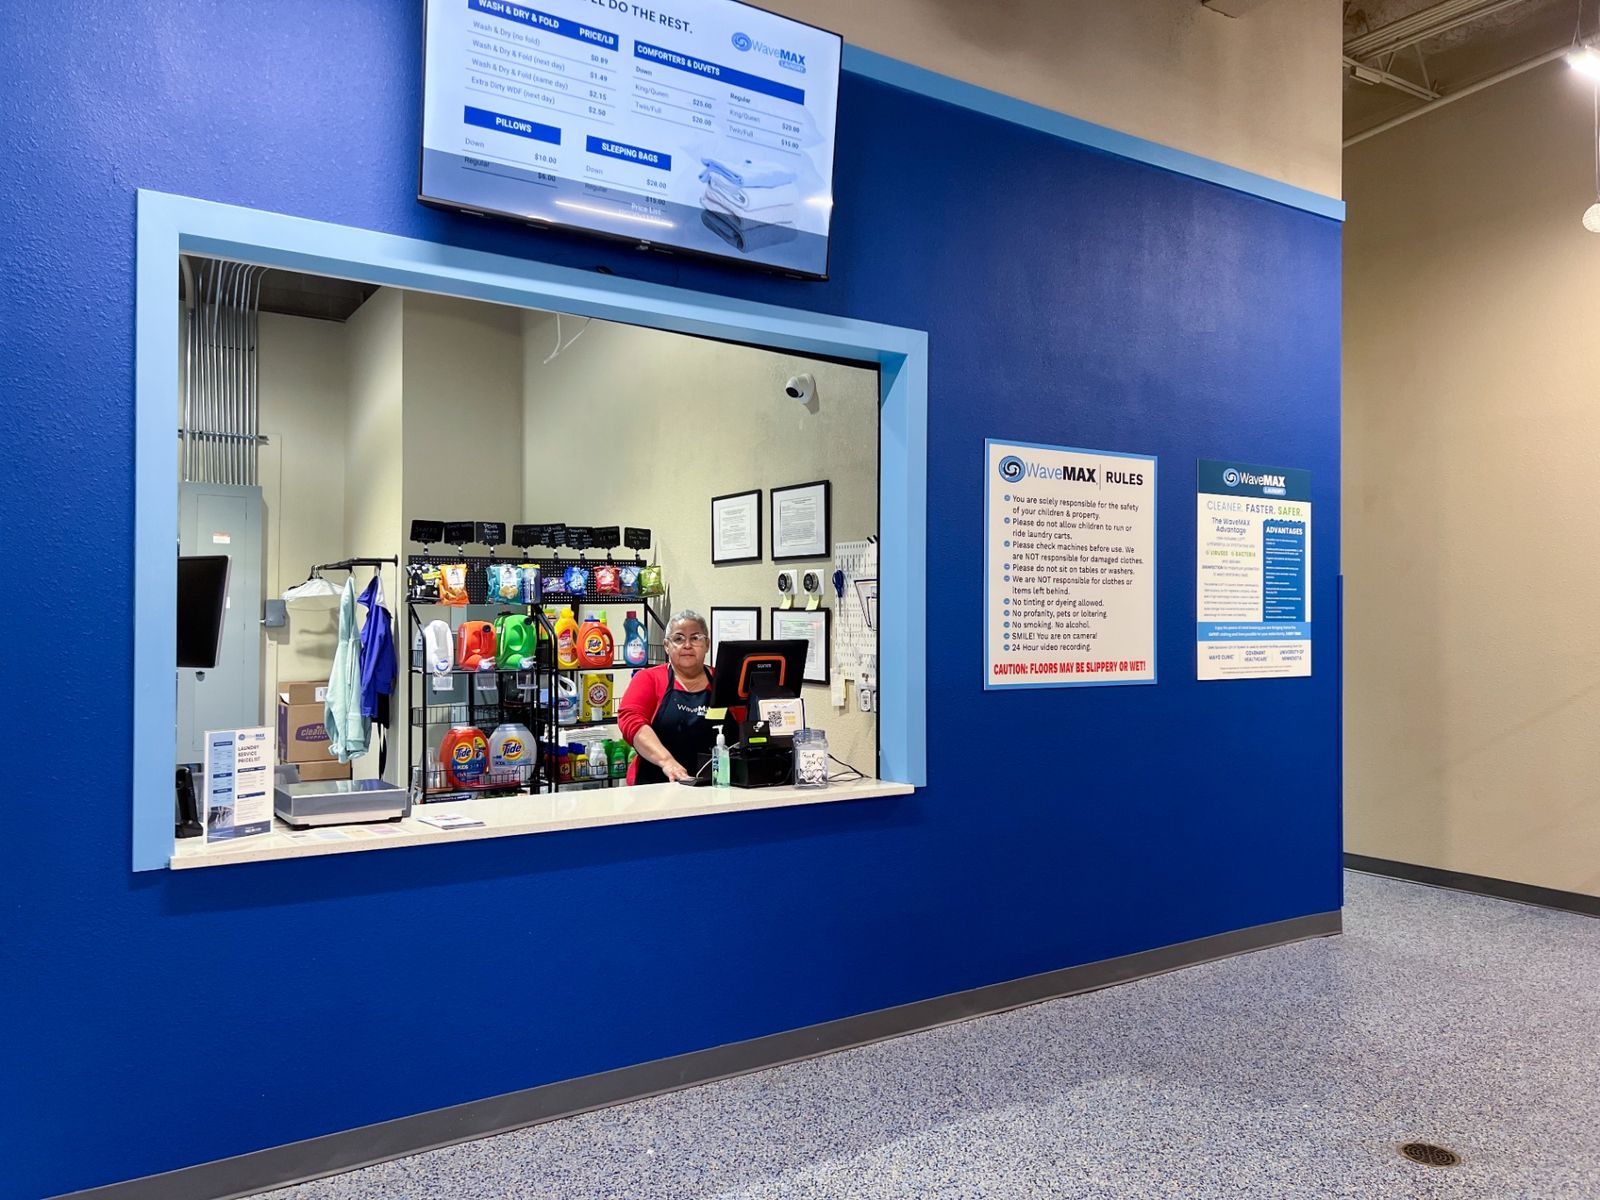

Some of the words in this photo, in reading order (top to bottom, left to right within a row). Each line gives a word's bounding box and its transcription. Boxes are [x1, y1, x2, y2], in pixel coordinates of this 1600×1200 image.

[478, 0, 504, 13] WASH
[506, 6, 512, 15] &
[514, 8, 529, 20] DRY
[531, 14, 537, 22] &
[539, 16, 559, 28] FOLD
[580, 27, 614, 45] PRICE/LB
[609, 0, 628, 13] DO
[632, 5, 656, 22] THE
[659, 14, 693, 34] REST.
[473, 20, 492, 32] Wash
[500, 27, 511, 38] Dry
[472, 39, 492, 51] Wash
[500, 46, 510, 56] Dry
[518, 51, 532, 63] Fold
[752, 40, 806, 66] WaveMAX
[638, 45, 686, 66] COMFORTERS
[687, 58, 692, 68] &
[693, 61, 720, 76] DUVETS
[472, 58, 491, 69] Wash
[499, 64, 509, 75] Dry
[517, 70, 532, 81] Fold
[471, 76, 488, 87] Extra
[490, 81, 505, 92] Dirty
[496, 117, 532, 133] PILLOWS
[465, 138, 485, 148] Down
[602, 142, 637, 158] SLEEPING
[638, 152, 658, 163] BAGS
[1026, 462, 1096, 483] WaveMAX
[1106, 471, 1144, 486] RULES
[1240, 472, 1285, 487] WaveMAX
[1038, 497, 1058, 507] solely
[1059, 499, 1096, 507] responsible
[1097, 500, 1107, 508] for
[1120, 502, 1138, 512] safety
[1020, 508, 1036, 516] your
[1037, 508, 1064, 516] children
[1065, 509, 1070, 517] &
[1012, 518, 1034, 526] Please
[1212, 517, 1222, 525] The
[1012, 529, 1025, 537] ride
[1027, 530, 1052, 540] laundry
[1216, 525, 1246, 535] Advantage
[1266, 526, 1303, 535] ADVANTAGES
[1012, 540, 1034, 548] Please
[1056, 543, 1088, 551] machines
[1089, 544, 1109, 552] before
[1025, 552, 1038, 560] NOT
[1040, 554, 1078, 562] responsible
[1079, 554, 1088, 562] for
[1090, 555, 1118, 564] damaged
[1037, 575, 1050, 583] NOT
[1052, 576, 1089, 585] responsible
[1091, 576, 1100, 584] for
[1012, 586, 1031, 594] items
[1023, 598, 1044, 607] tinting
[1055, 598, 1076, 607] dyeing
[1023, 609, 1055, 618] profanity,
[1056, 610, 1071, 618] pets
[1012, 643, 1020, 651] 24
[993, 663, 1028, 674] CAUTION:
[1029, 662, 1058, 673] FLOORS
[1059, 662, 1074, 672] MAY
[1075, 662, 1084, 672] BE
[1086, 661, 1117, 672] SLIPPERY
[1118, 661, 1128, 671] OR
[1129, 660, 1145, 670] WET!
[456, 747, 471, 759] Tide
[503, 743, 522, 756] Tide
